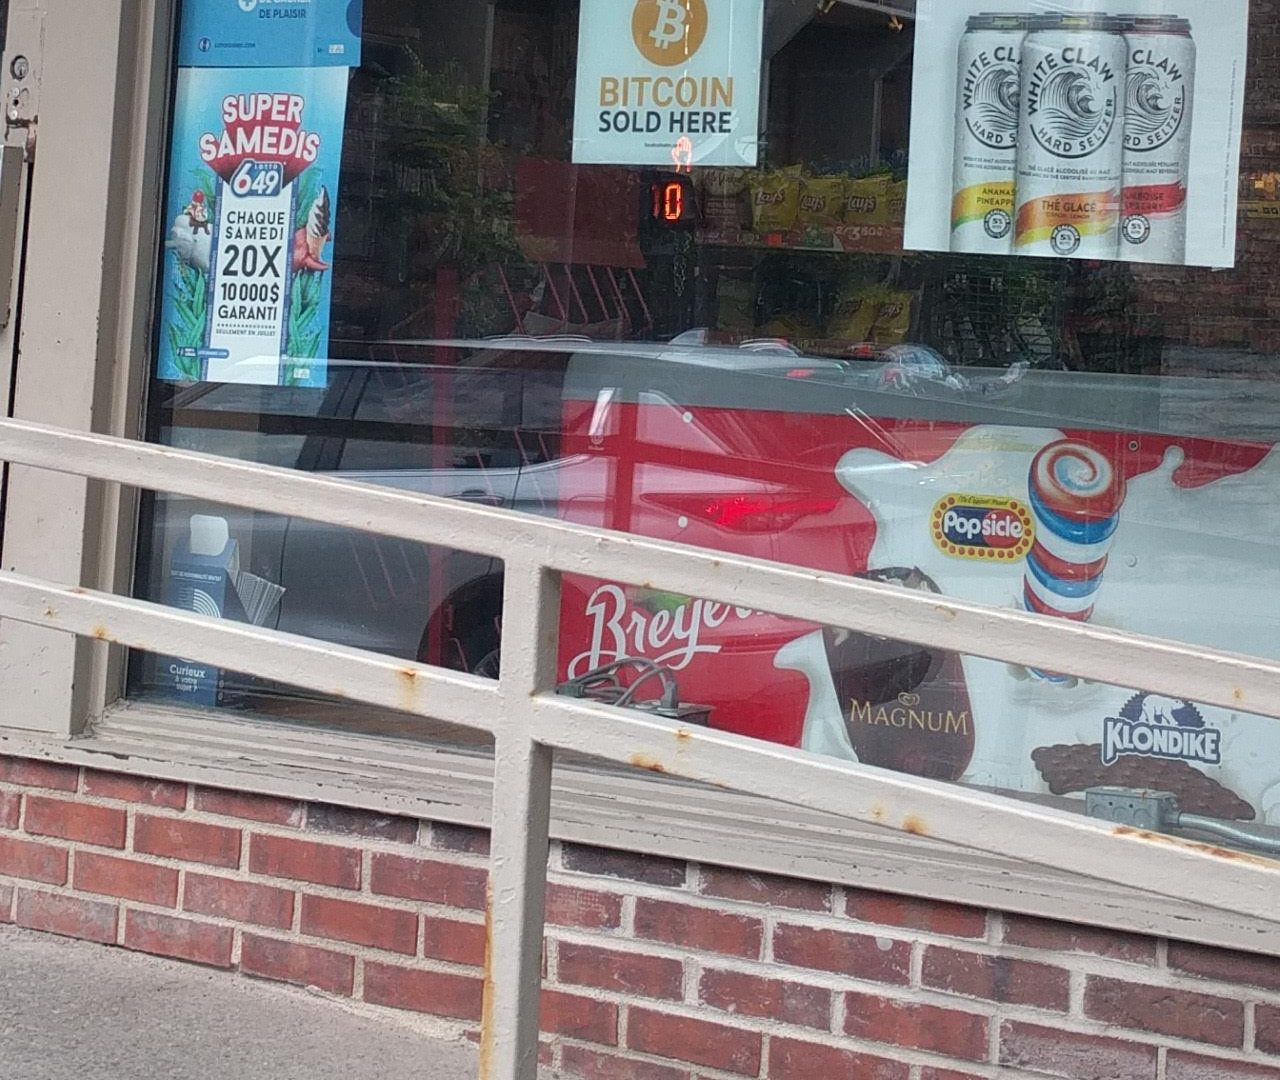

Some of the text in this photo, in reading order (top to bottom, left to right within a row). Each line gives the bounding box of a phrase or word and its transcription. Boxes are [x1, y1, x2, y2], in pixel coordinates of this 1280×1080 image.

[258, 8, 307, 20] DE PLAISIR
[963, 51, 991, 111] WHITE
[1027, 47, 1115, 116] WHITE CLAW
[1131, 49, 1183, 83] CLAW
[599, 76, 734, 108] BITCOIN
[222, 93, 304, 124] SUPER
[598, 111, 732, 134] SOLD HERE
[1147, 96, 1182, 146] SELTZER
[972, 120, 1004, 144] HARD
[1038, 98, 1113, 153] HARD SELTZER
[199, 126, 320, 162] SAMEDIS
[233, 163, 281, 196] 649
[982, 187, 1016, 196] ANANAS
[976, 196, 1015, 206] PINEAPPL
[1042, 198, 1097, 212] THÉ GLACÉ
[225, 226, 284, 240] SAMEDI
[226, 211, 286, 226] CHAQUE
[222, 244, 282, 278] 20X
[218, 304, 278, 321] GARANTI
[215, 328, 247, 336] SEULEMENT
[943, 510, 1023, 539] Popsicle
[568, 584, 763, 684] Breye
[169, 664, 206, 679] Curieux
[850, 698, 969, 735] MAGNUM
[1105, 720, 1220, 764] KLONDIKE
